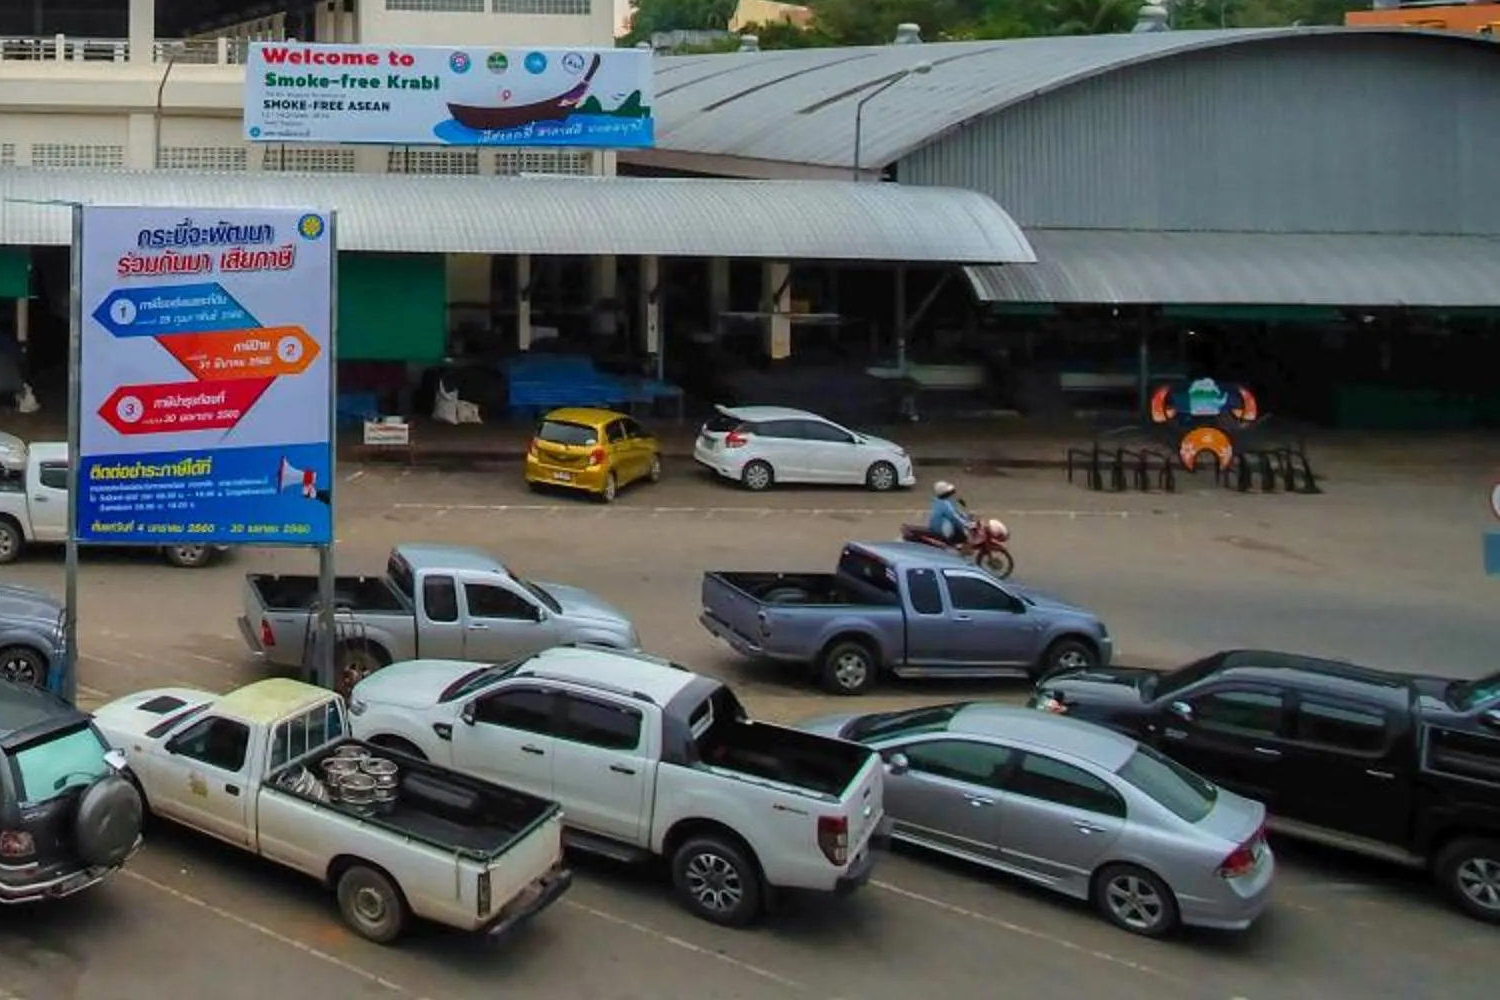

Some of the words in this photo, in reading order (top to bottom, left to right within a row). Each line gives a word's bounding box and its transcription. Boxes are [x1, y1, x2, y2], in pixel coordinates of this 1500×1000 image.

[262, 48, 379, 65] Welcome
[389, 51, 414, 66] to
[265, 72, 380, 88] Smoke-free
[387, 75, 439, 90] Krabi
[263, 100, 344, 111] SMOKE-FREE
[348, 102, 390, 111] ASEAN
[137, 218, 274, 248] กระบี่จะพัฒนา
[219, 244, 296, 273] เสียภาษี
[286, 343, 296, 357] 2
[124, 402, 135, 416] 3
